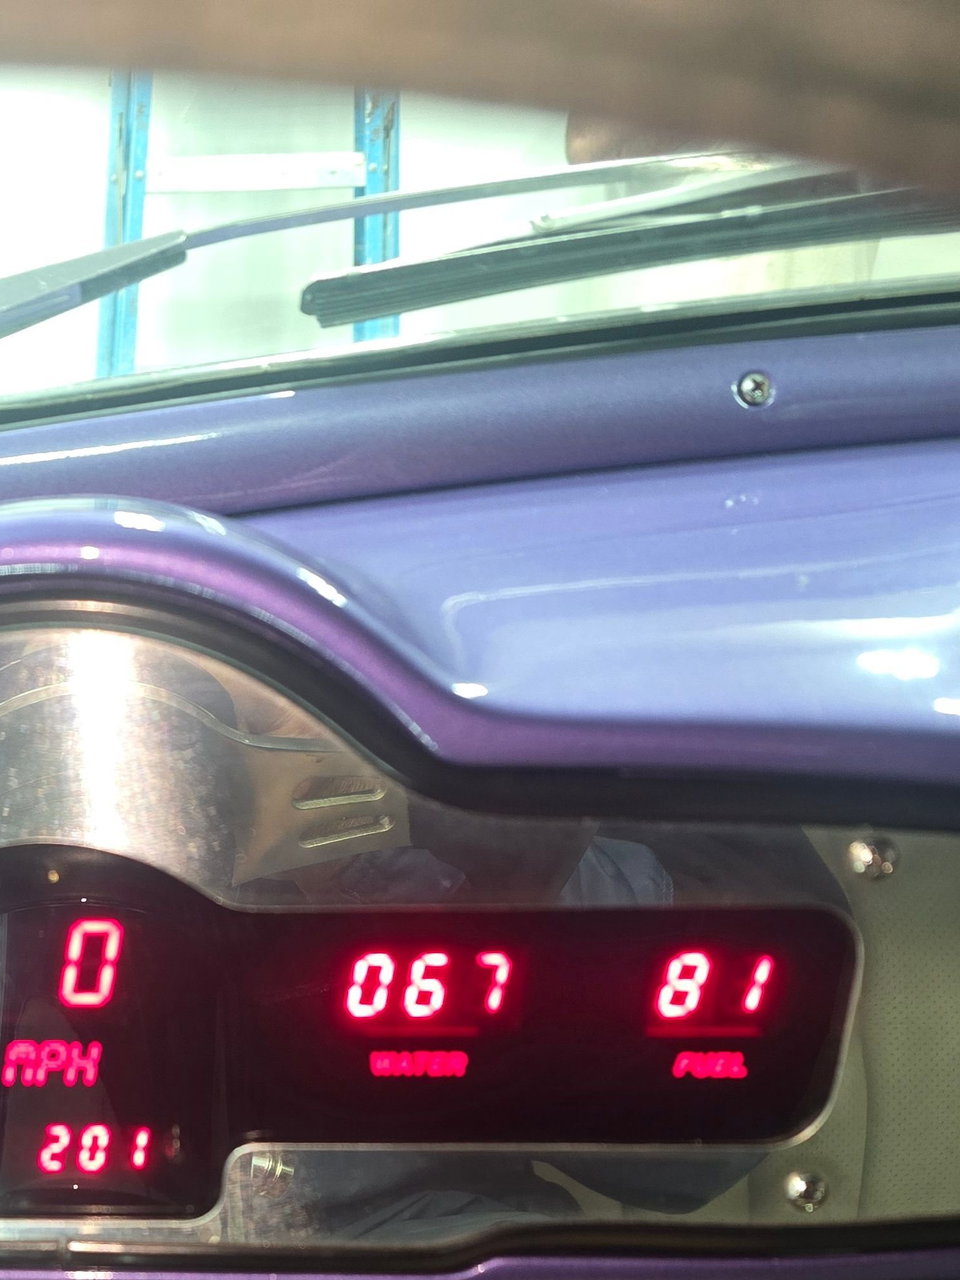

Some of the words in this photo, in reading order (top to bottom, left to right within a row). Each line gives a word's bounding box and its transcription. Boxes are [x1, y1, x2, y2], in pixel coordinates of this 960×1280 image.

[59, 918, 124, 1008] 0
[345, 951, 512, 1018] 067
[656, 951, 774, 1018] 81
[1, 1040, 103, 1087] MPH
[369, 1050, 468, 1078] WATER
[672, 1051, 748, 1079] FUEL
[37, 1122, 152, 1174] 201
